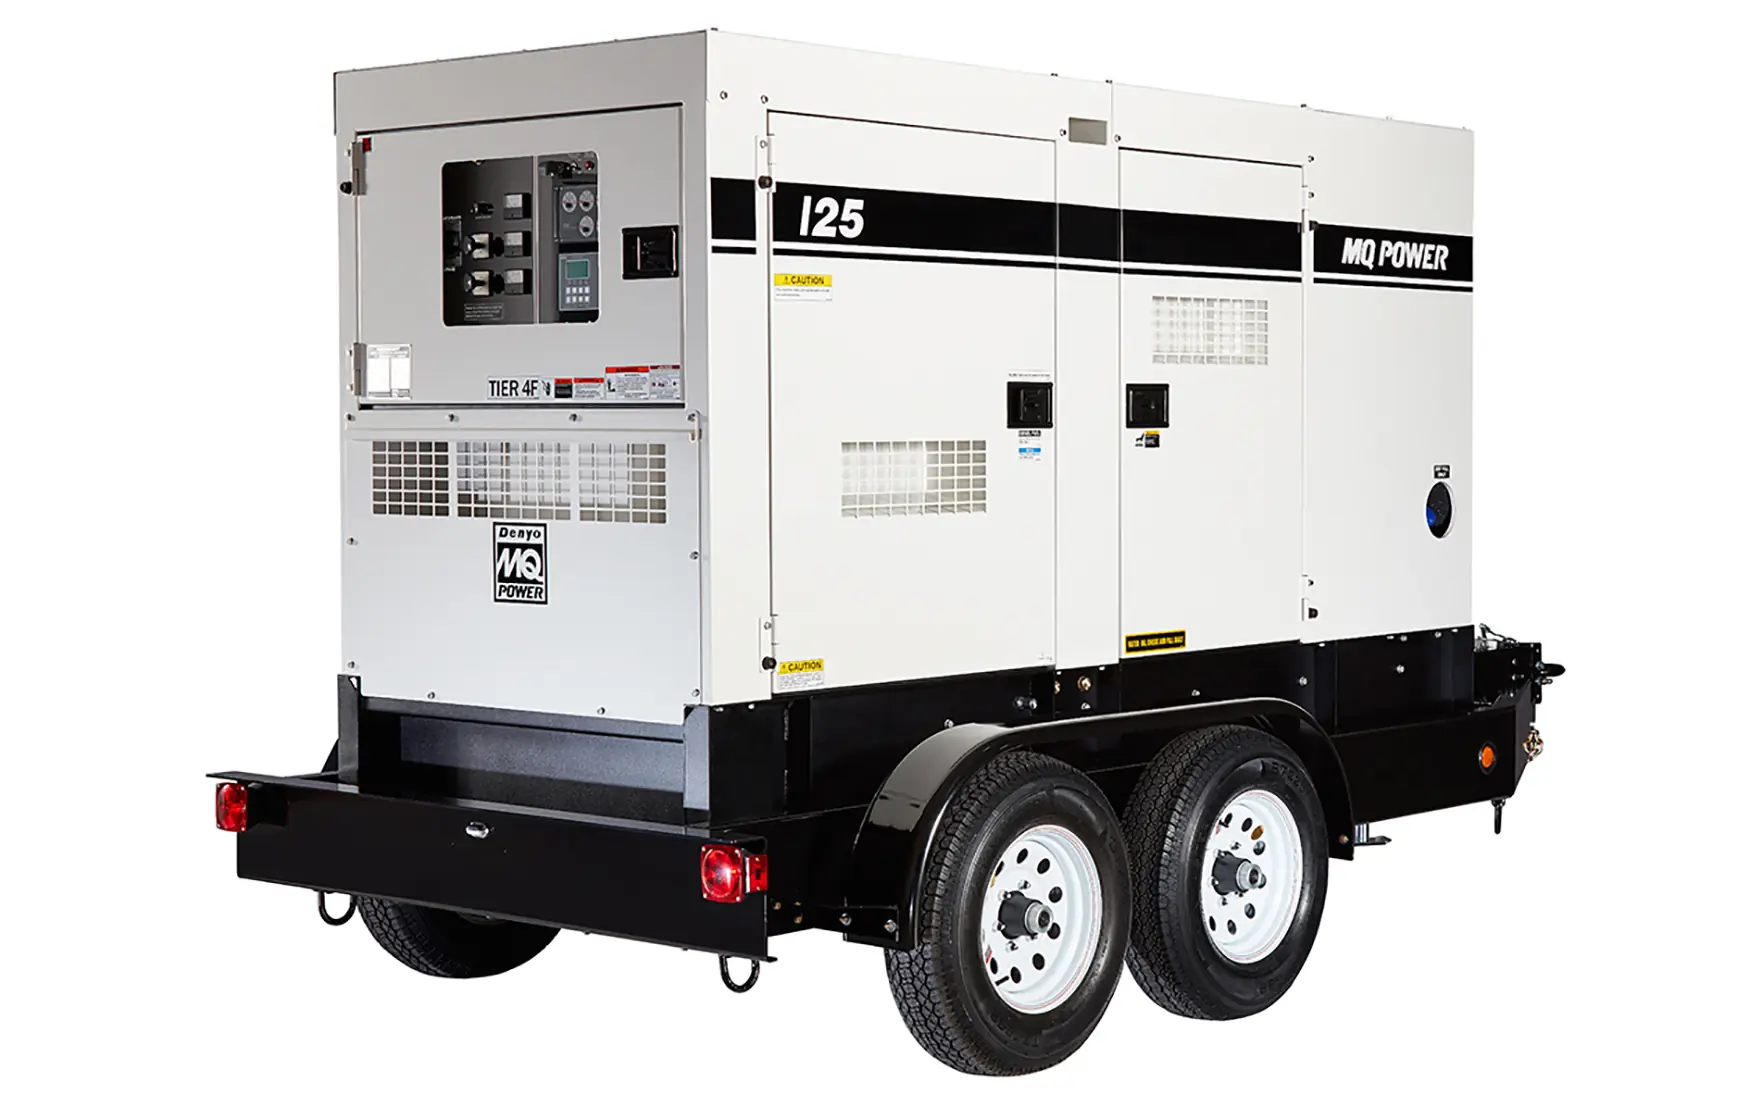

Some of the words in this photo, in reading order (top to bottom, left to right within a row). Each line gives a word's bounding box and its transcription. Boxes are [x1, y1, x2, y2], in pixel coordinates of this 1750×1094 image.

[799, 195, 865, 239] 125
[1341, 237, 1376, 270] MQ
[1378, 240, 1449, 271] POWER
[790, 275, 825, 285] CAUTION
[488, 379, 519, 397] TIER
[521, 379, 539, 397] 4F
[499, 526, 542, 541] Denyo
[497, 547, 544, 582] MQ
[498, 584, 544, 600] POWER
[788, 660, 822, 672] CAUTION
